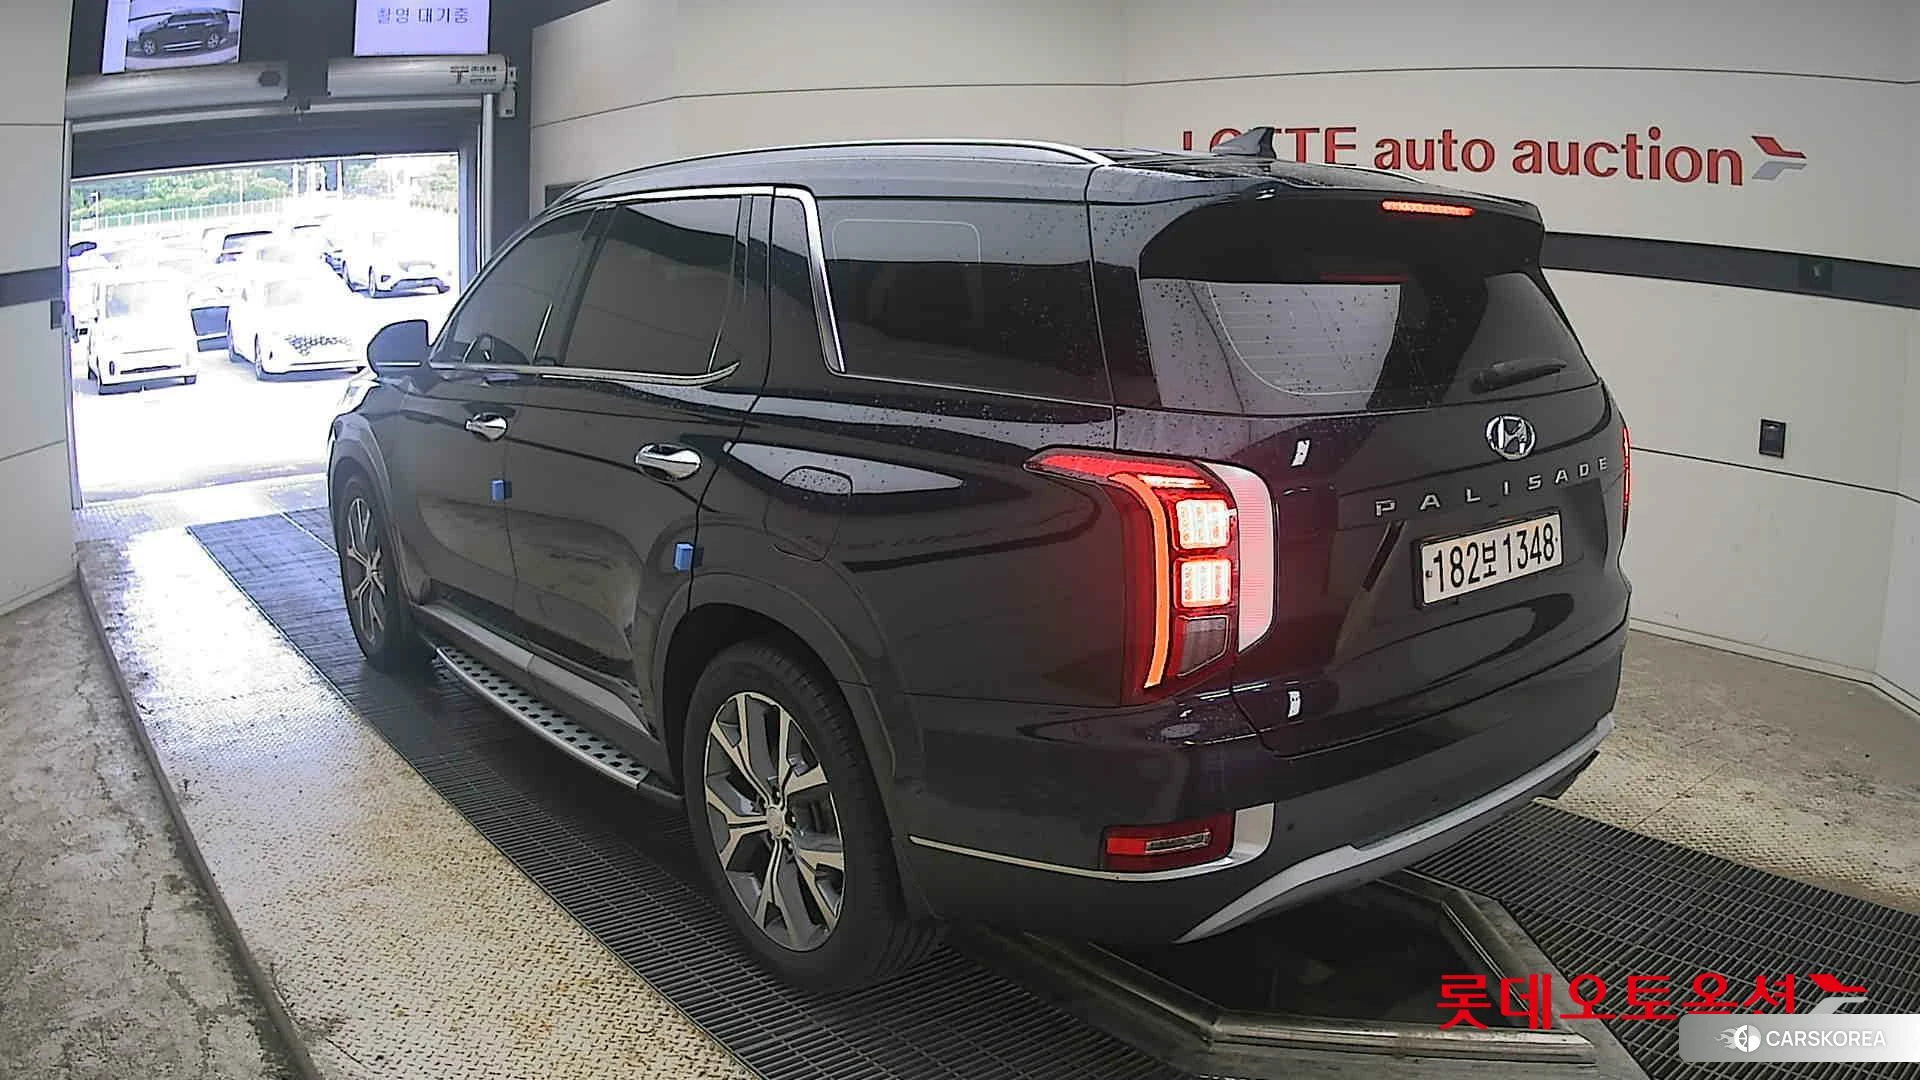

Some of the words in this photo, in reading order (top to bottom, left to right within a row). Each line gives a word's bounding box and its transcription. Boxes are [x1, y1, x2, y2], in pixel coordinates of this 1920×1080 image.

[418, 7, 469, 24] 대기중
[1373, 129, 1496, 172] auto
[1512, 126, 1744, 186] auction
[1375, 456, 1609, 517] PALISADE
[1433, 539, 1497, 592] 182보
[1502, 522, 1555, 573] 1348
